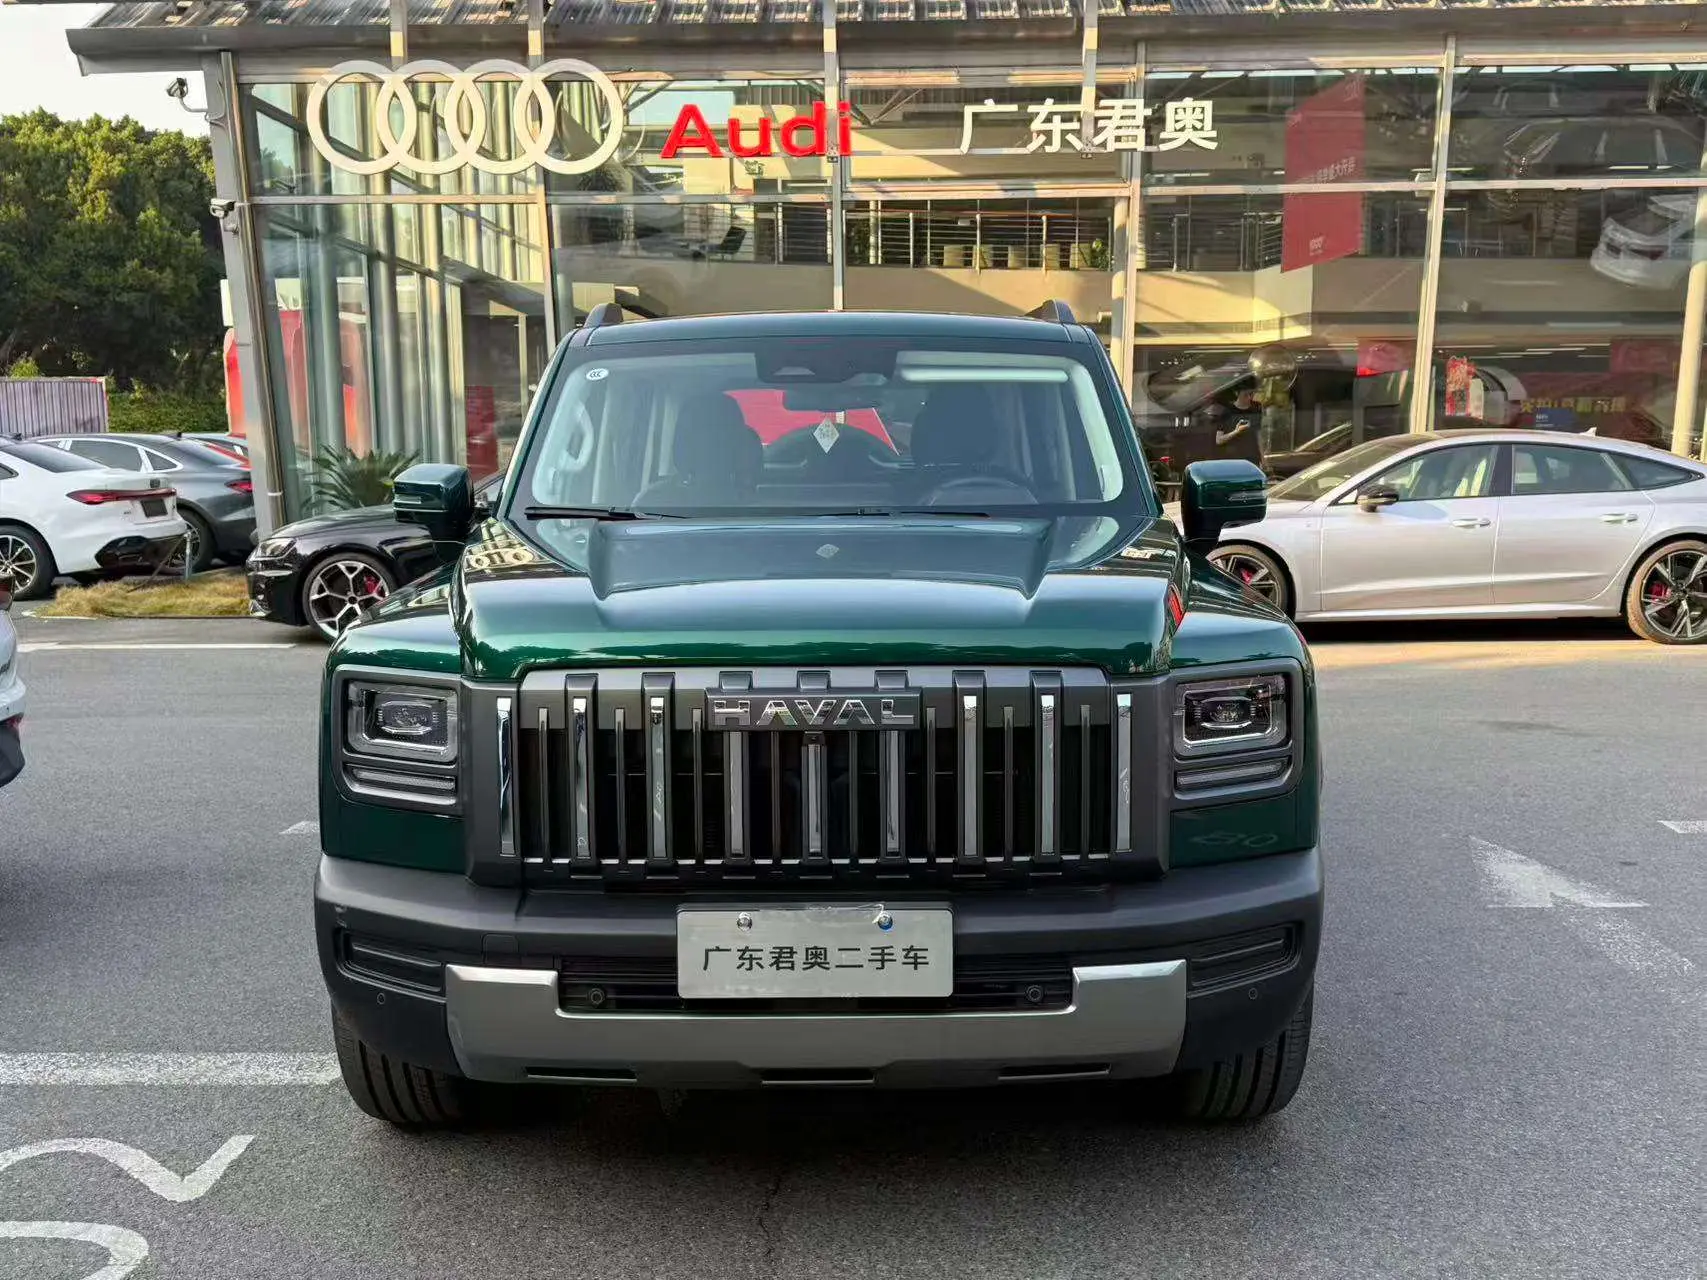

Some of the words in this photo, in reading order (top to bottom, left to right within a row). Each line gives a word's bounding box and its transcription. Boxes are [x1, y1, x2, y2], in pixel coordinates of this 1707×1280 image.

[661, 101, 852, 158] Audi
[960, 97, 1218, 154] 广东君奥
[713, 699, 914, 725] HAVAL
[703, 946, 929, 971] 广东君奥二手车
